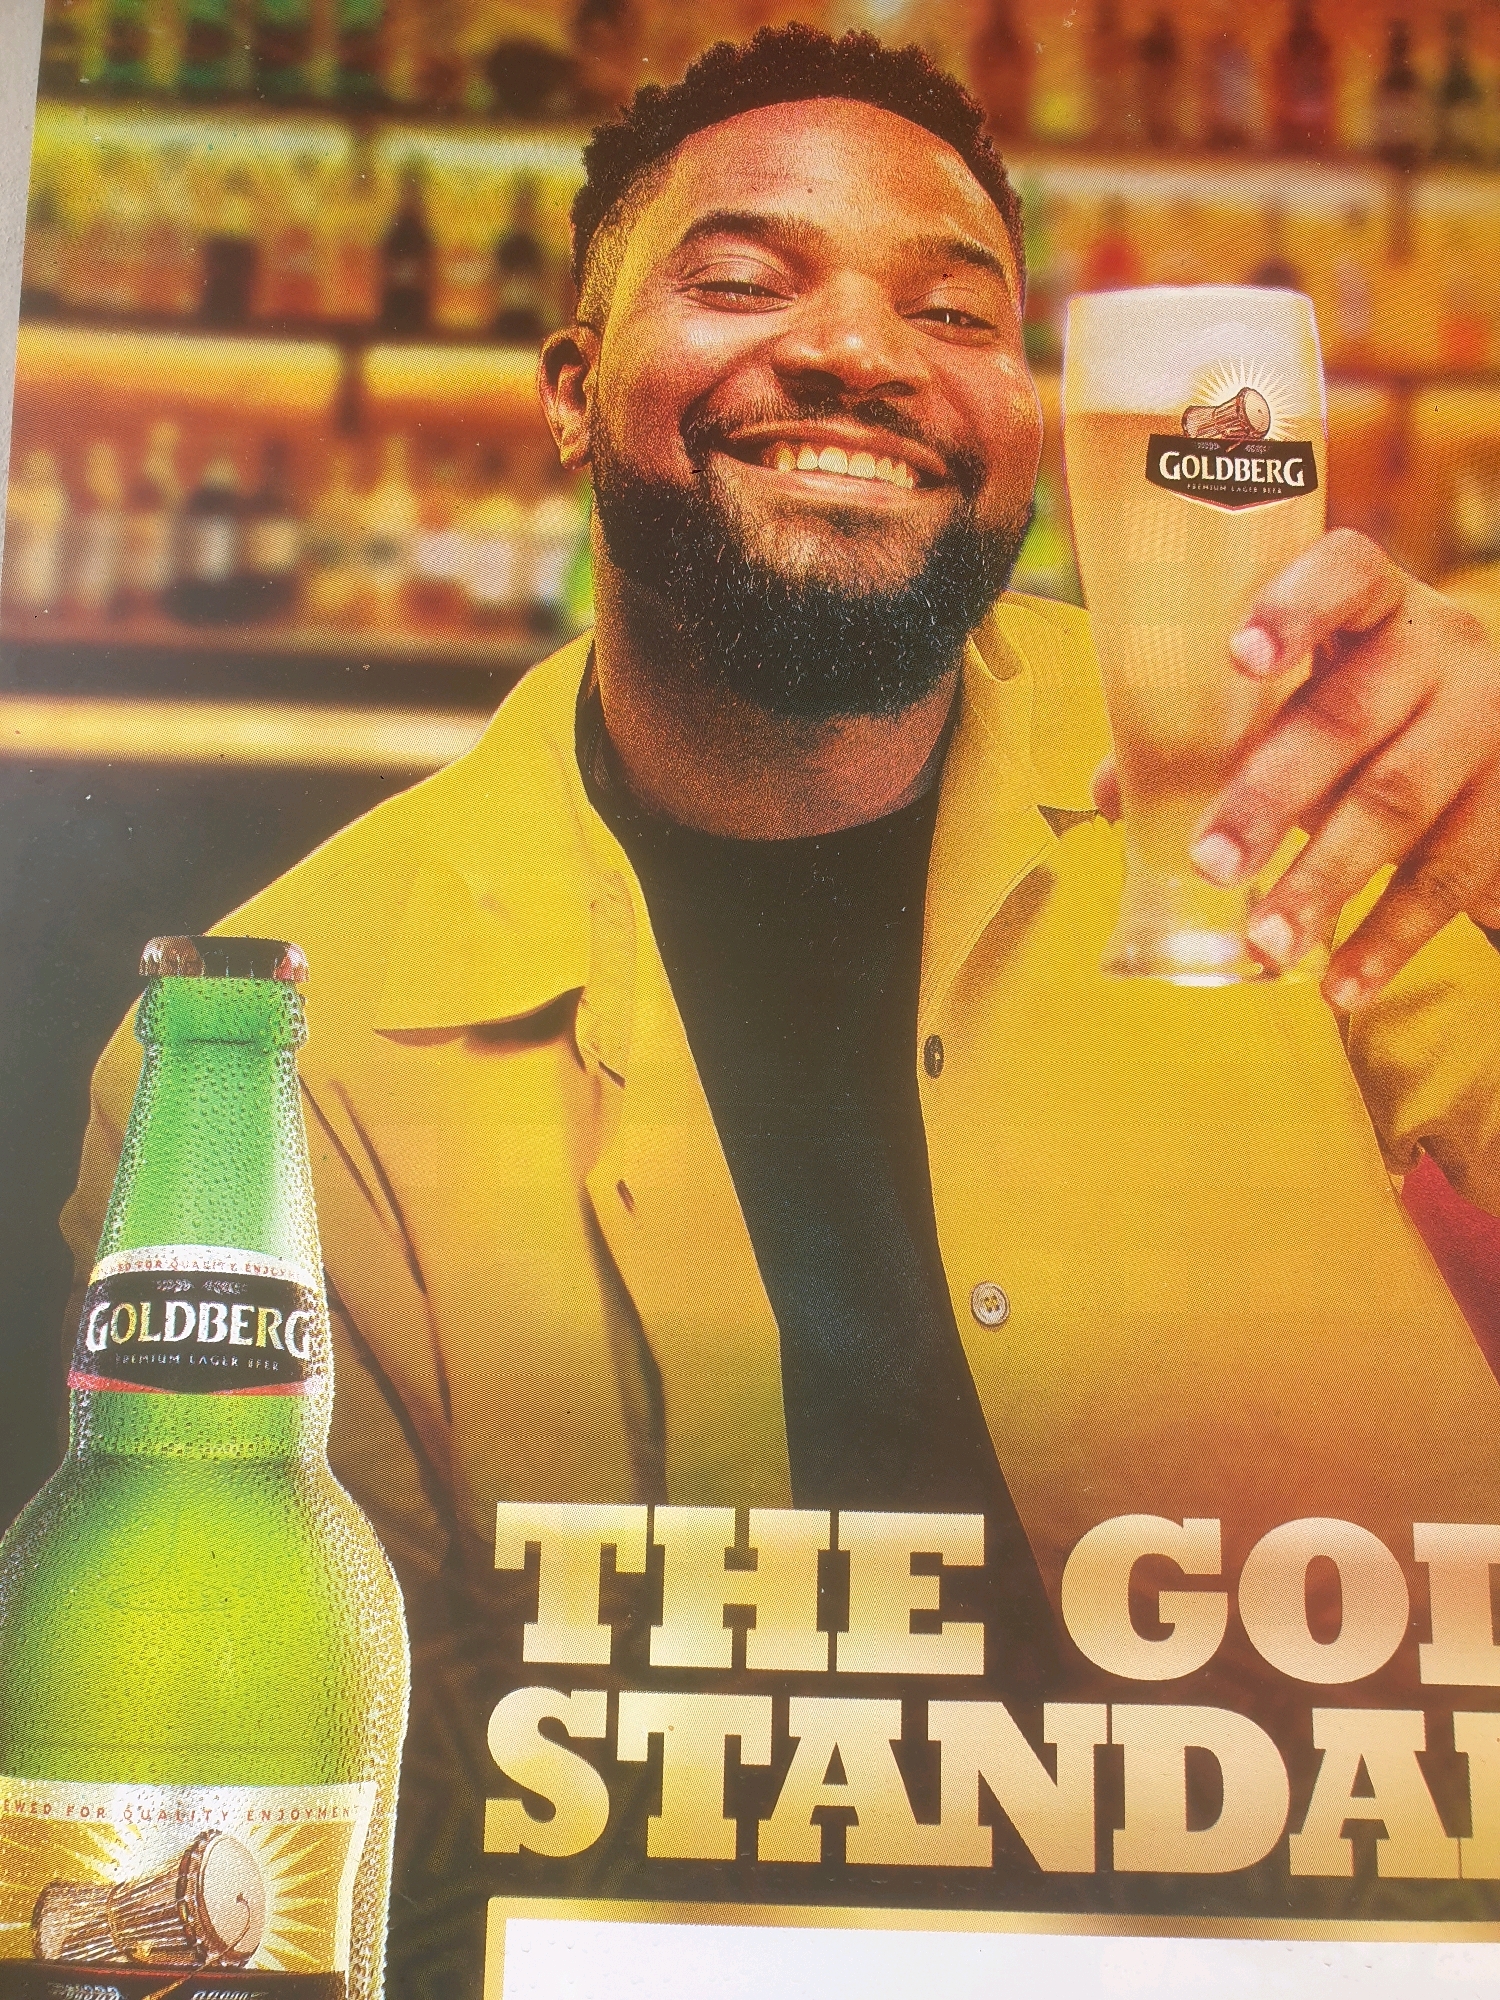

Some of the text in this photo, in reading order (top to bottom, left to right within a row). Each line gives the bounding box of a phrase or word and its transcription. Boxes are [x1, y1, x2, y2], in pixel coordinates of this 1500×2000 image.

[1158, 451, 1305, 487] GOLDBERG
[85, 1300, 313, 1360] GOLDBERG
[189, 1353, 238, 1367] LAGER
[494, 1502, 985, 1676] THE
[483, 1686, 1500, 1881] STANDA
[66, 1804, 105, 1818] FOR
[123, 1806, 229, 1822] QUALITY
